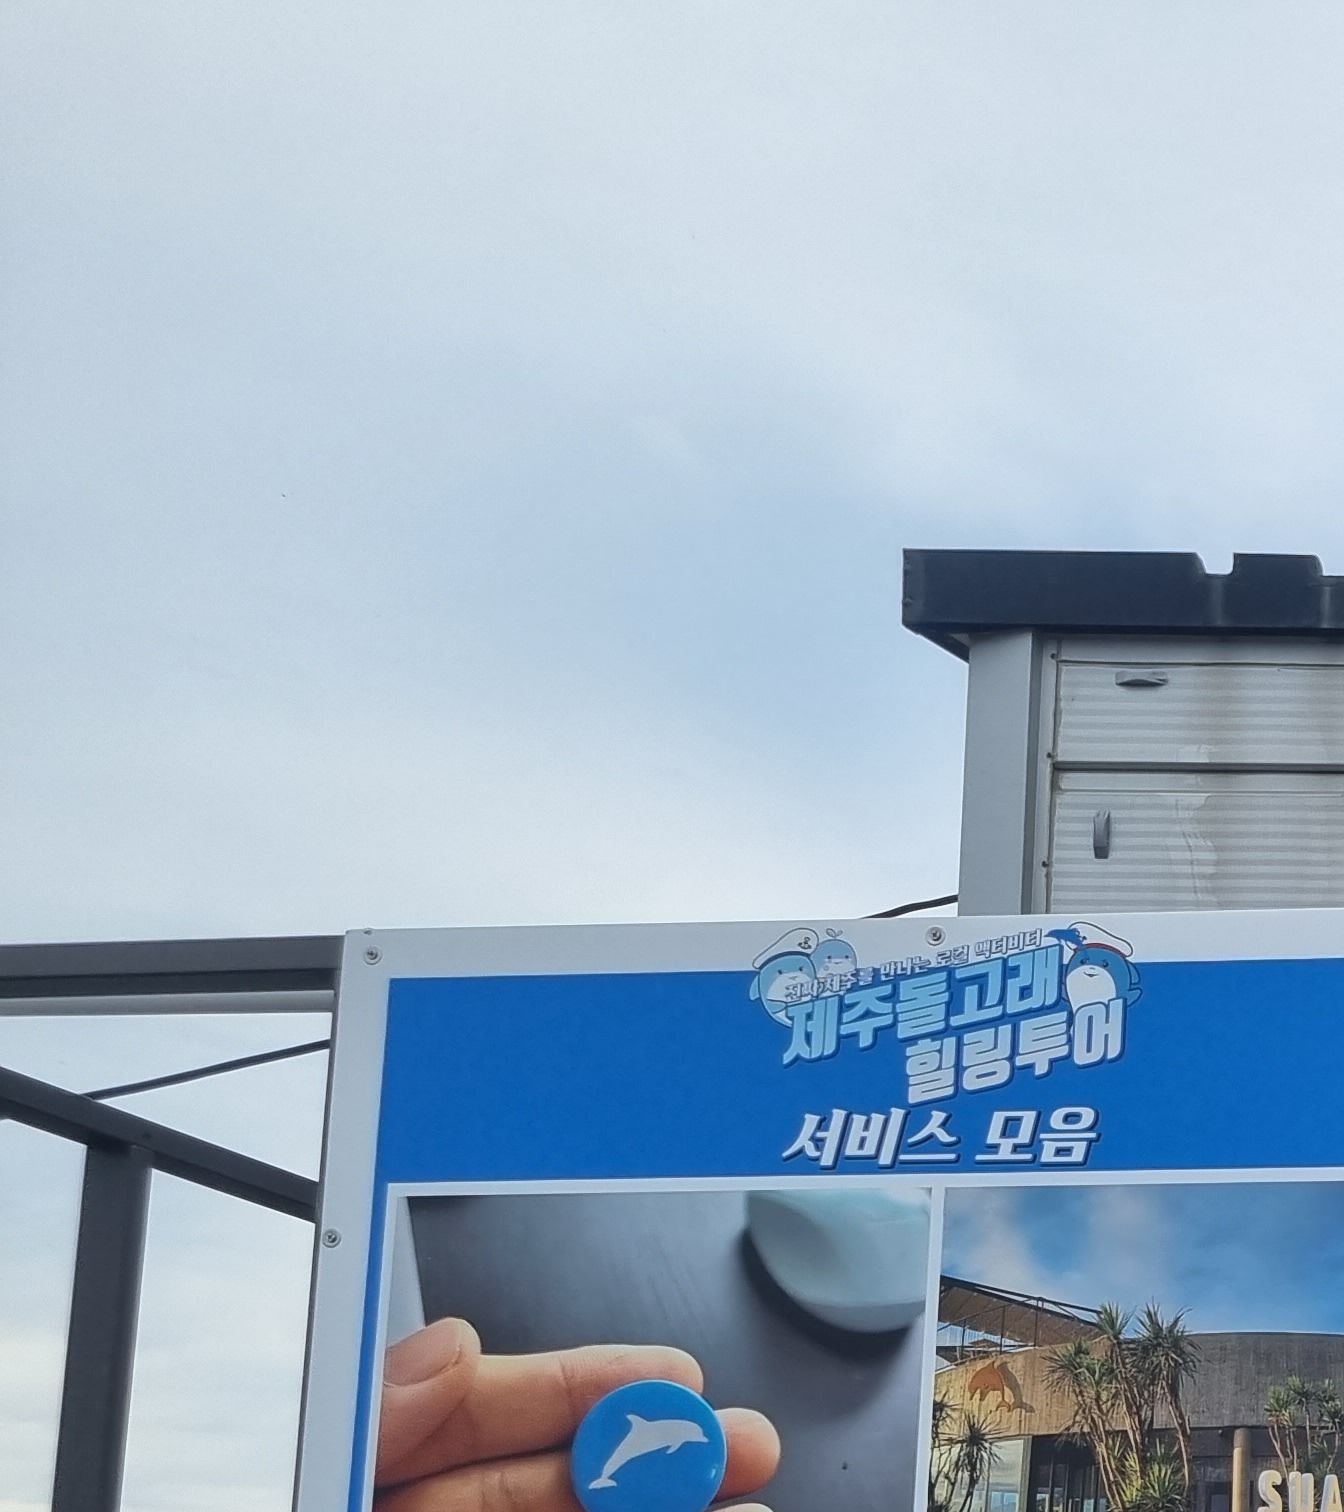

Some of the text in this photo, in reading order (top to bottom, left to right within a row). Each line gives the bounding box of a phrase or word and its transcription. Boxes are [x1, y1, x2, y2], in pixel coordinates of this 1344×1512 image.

[880, 955, 931, 980] 만나는
[936, 944, 970, 966] 로컬
[974, 928, 1042, 958] 액티비티
[783, 944, 1064, 1067] 제주돌고래
[906, 998, 1126, 1105] 힐링투어
[783, 1106, 1101, 1169] 서비스 모음
